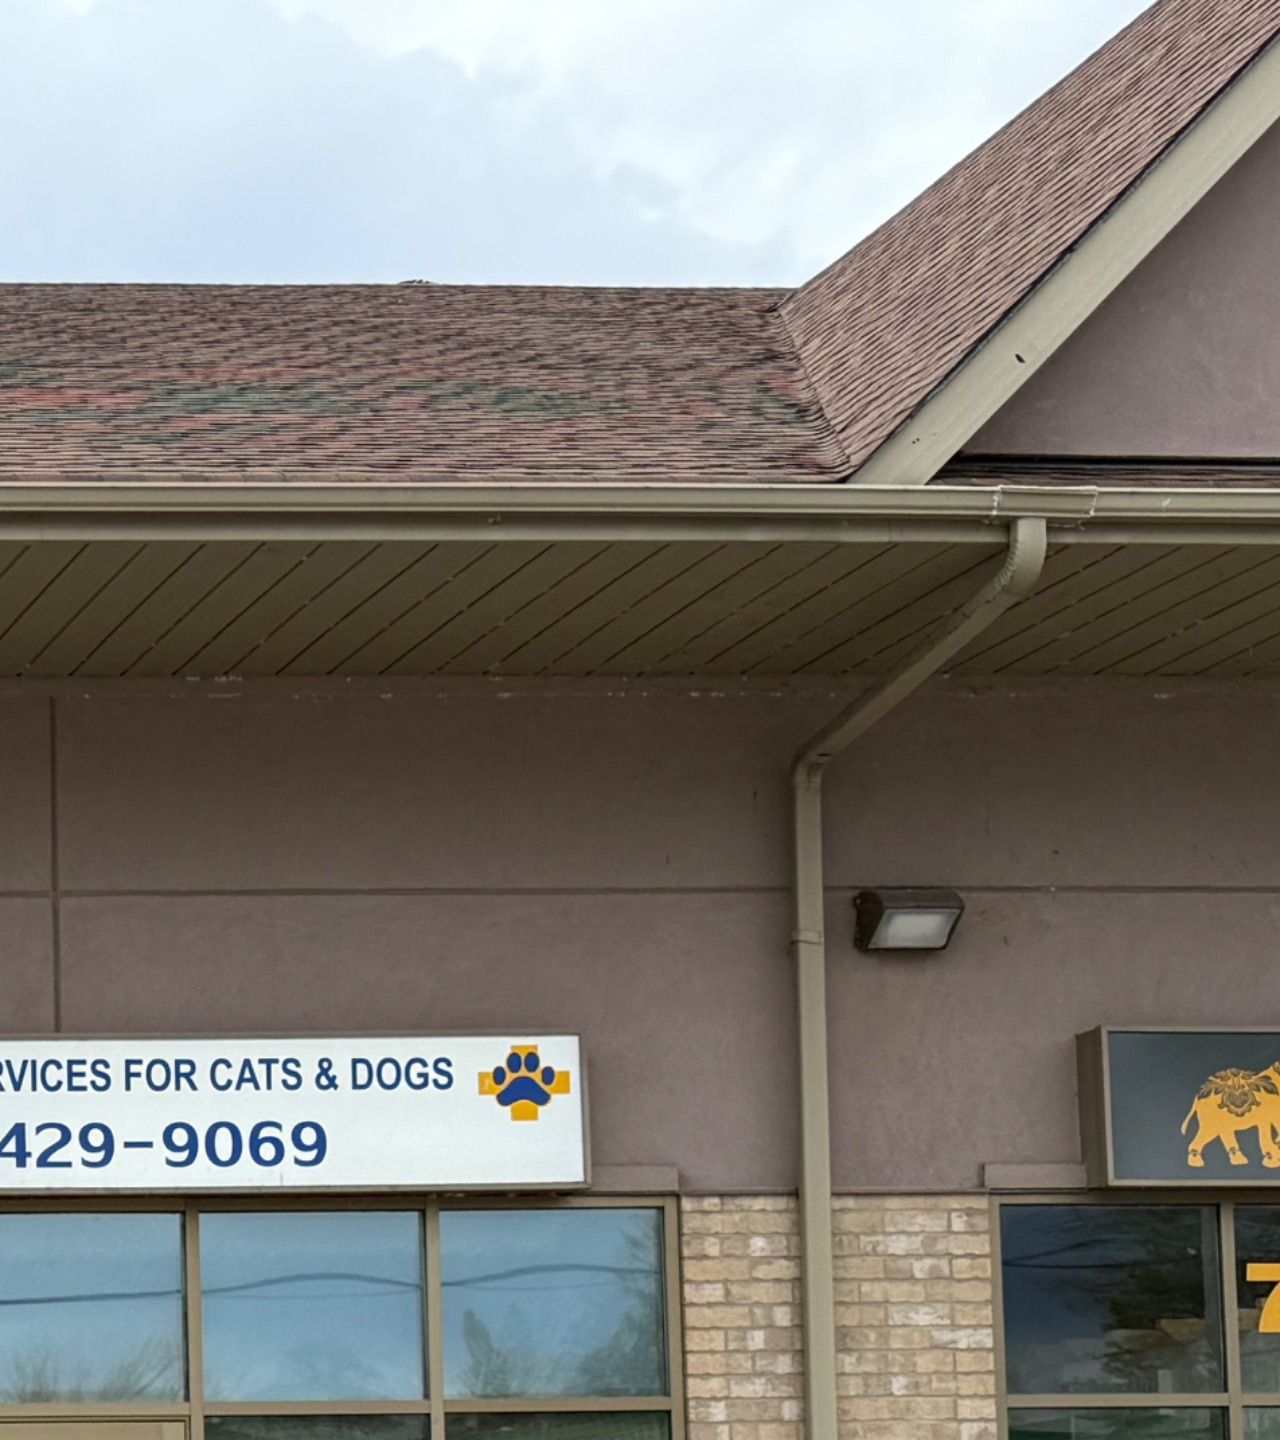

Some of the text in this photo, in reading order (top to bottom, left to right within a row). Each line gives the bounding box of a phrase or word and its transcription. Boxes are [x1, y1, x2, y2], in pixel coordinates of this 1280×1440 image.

[124, 1058, 198, 1092] FOR
[209, 1057, 303, 1092] CATS
[314, 1057, 340, 1091] &
[351, 1057, 454, 1091] DOGS
